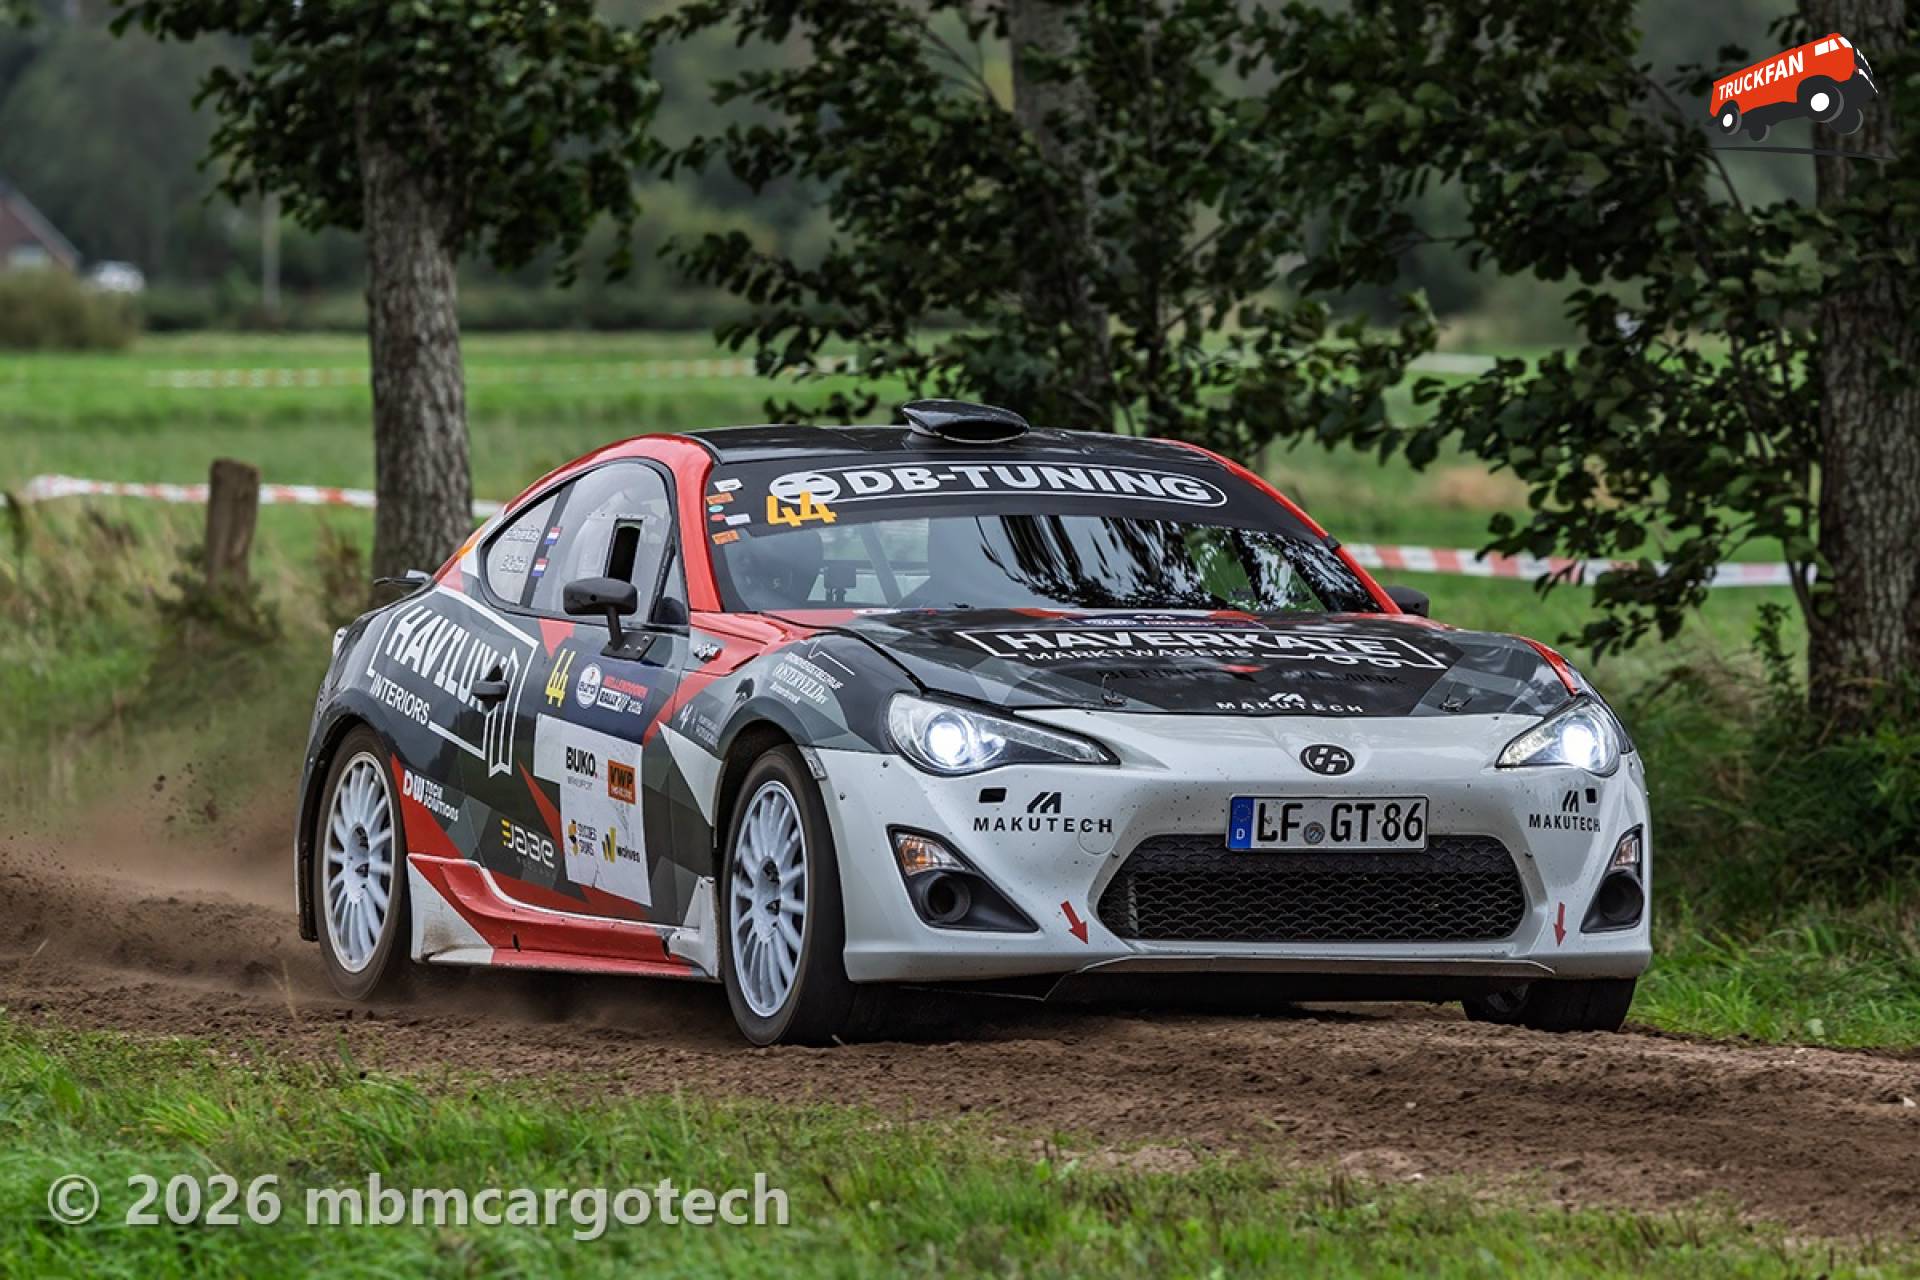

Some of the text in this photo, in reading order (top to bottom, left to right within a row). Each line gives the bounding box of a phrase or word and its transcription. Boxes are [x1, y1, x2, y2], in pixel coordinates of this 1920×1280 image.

[844, 465, 1212, 501] DB-TUNING
[766, 491, 838, 527] 44
[996, 631, 1402, 656] HAVERKATE
[545, 648, 576, 708] 44
[370, 673, 430, 726] INTERIORS
[1216, 701, 1364, 713] MAKUTECH
[973, 817, 1113, 833] MAKUTECH
[1235, 828, 1246, 841] D
[1256, 802, 1423, 843] LF GT 86
[1528, 813, 1601, 833] MAKUTECH
